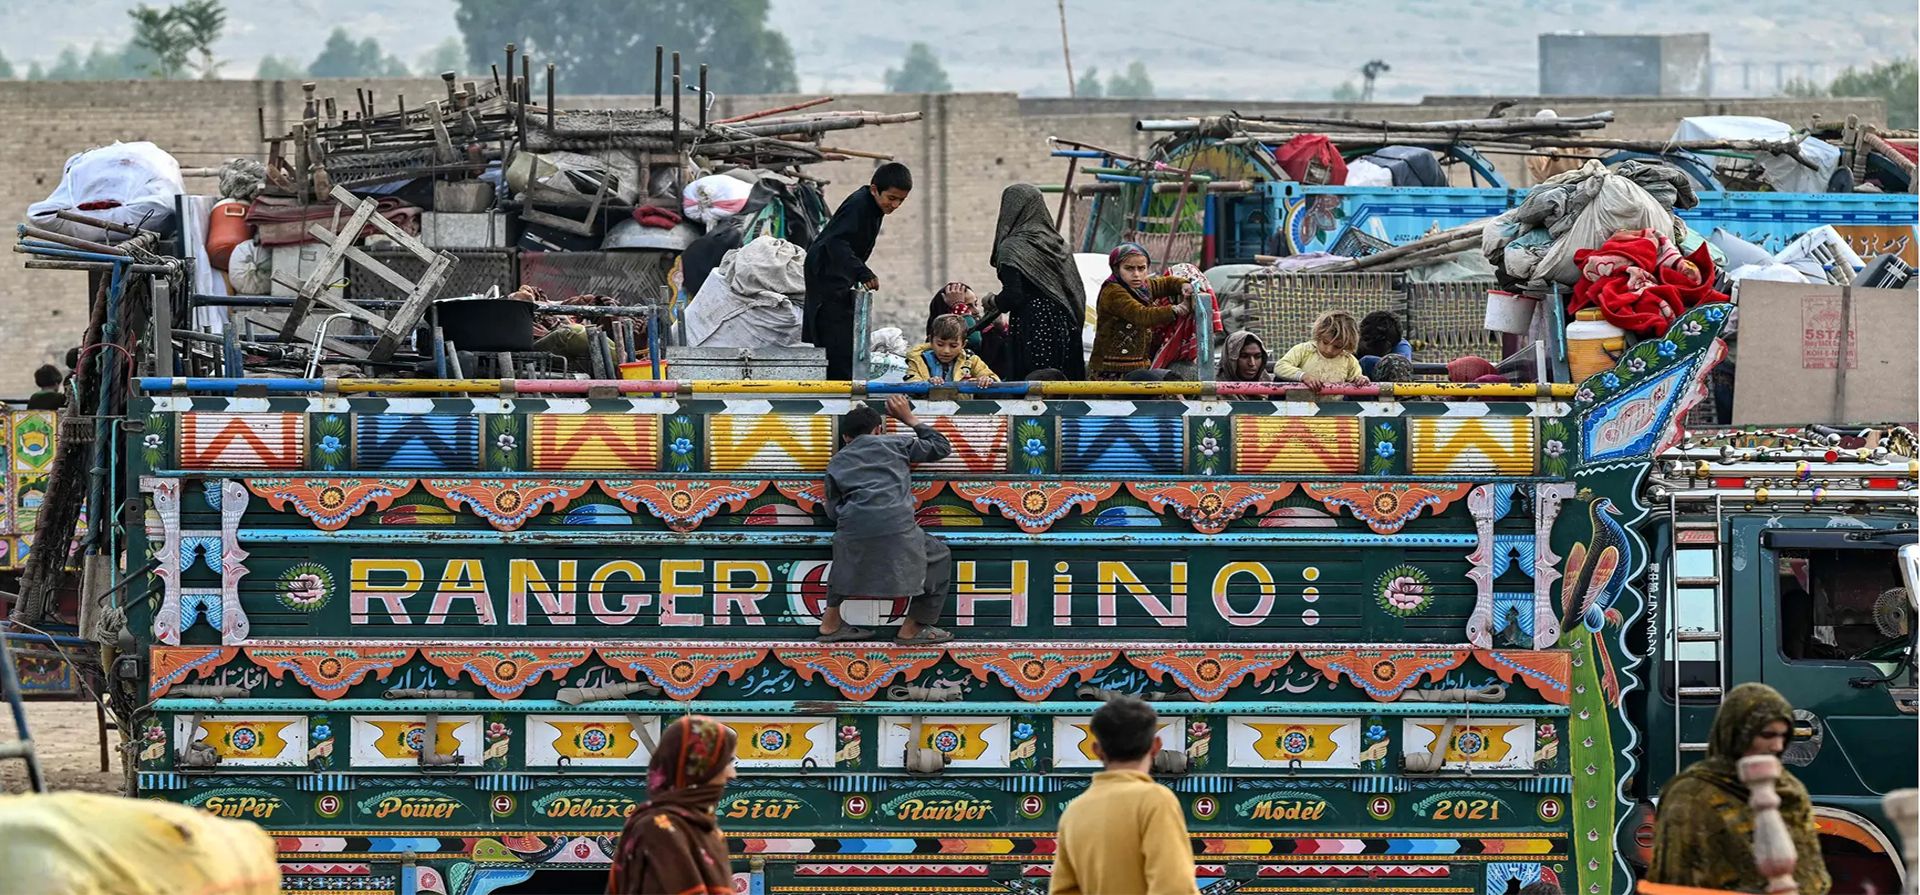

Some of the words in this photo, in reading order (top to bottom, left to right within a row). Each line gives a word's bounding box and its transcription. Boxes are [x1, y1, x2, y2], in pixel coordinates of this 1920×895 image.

[350, 558, 772, 627] RANGER
[376, 797, 465, 818] Power
[726, 797, 801, 819] Star
[1250, 800, 1327, 820] Model
[1432, 800, 1500, 820] 2021
